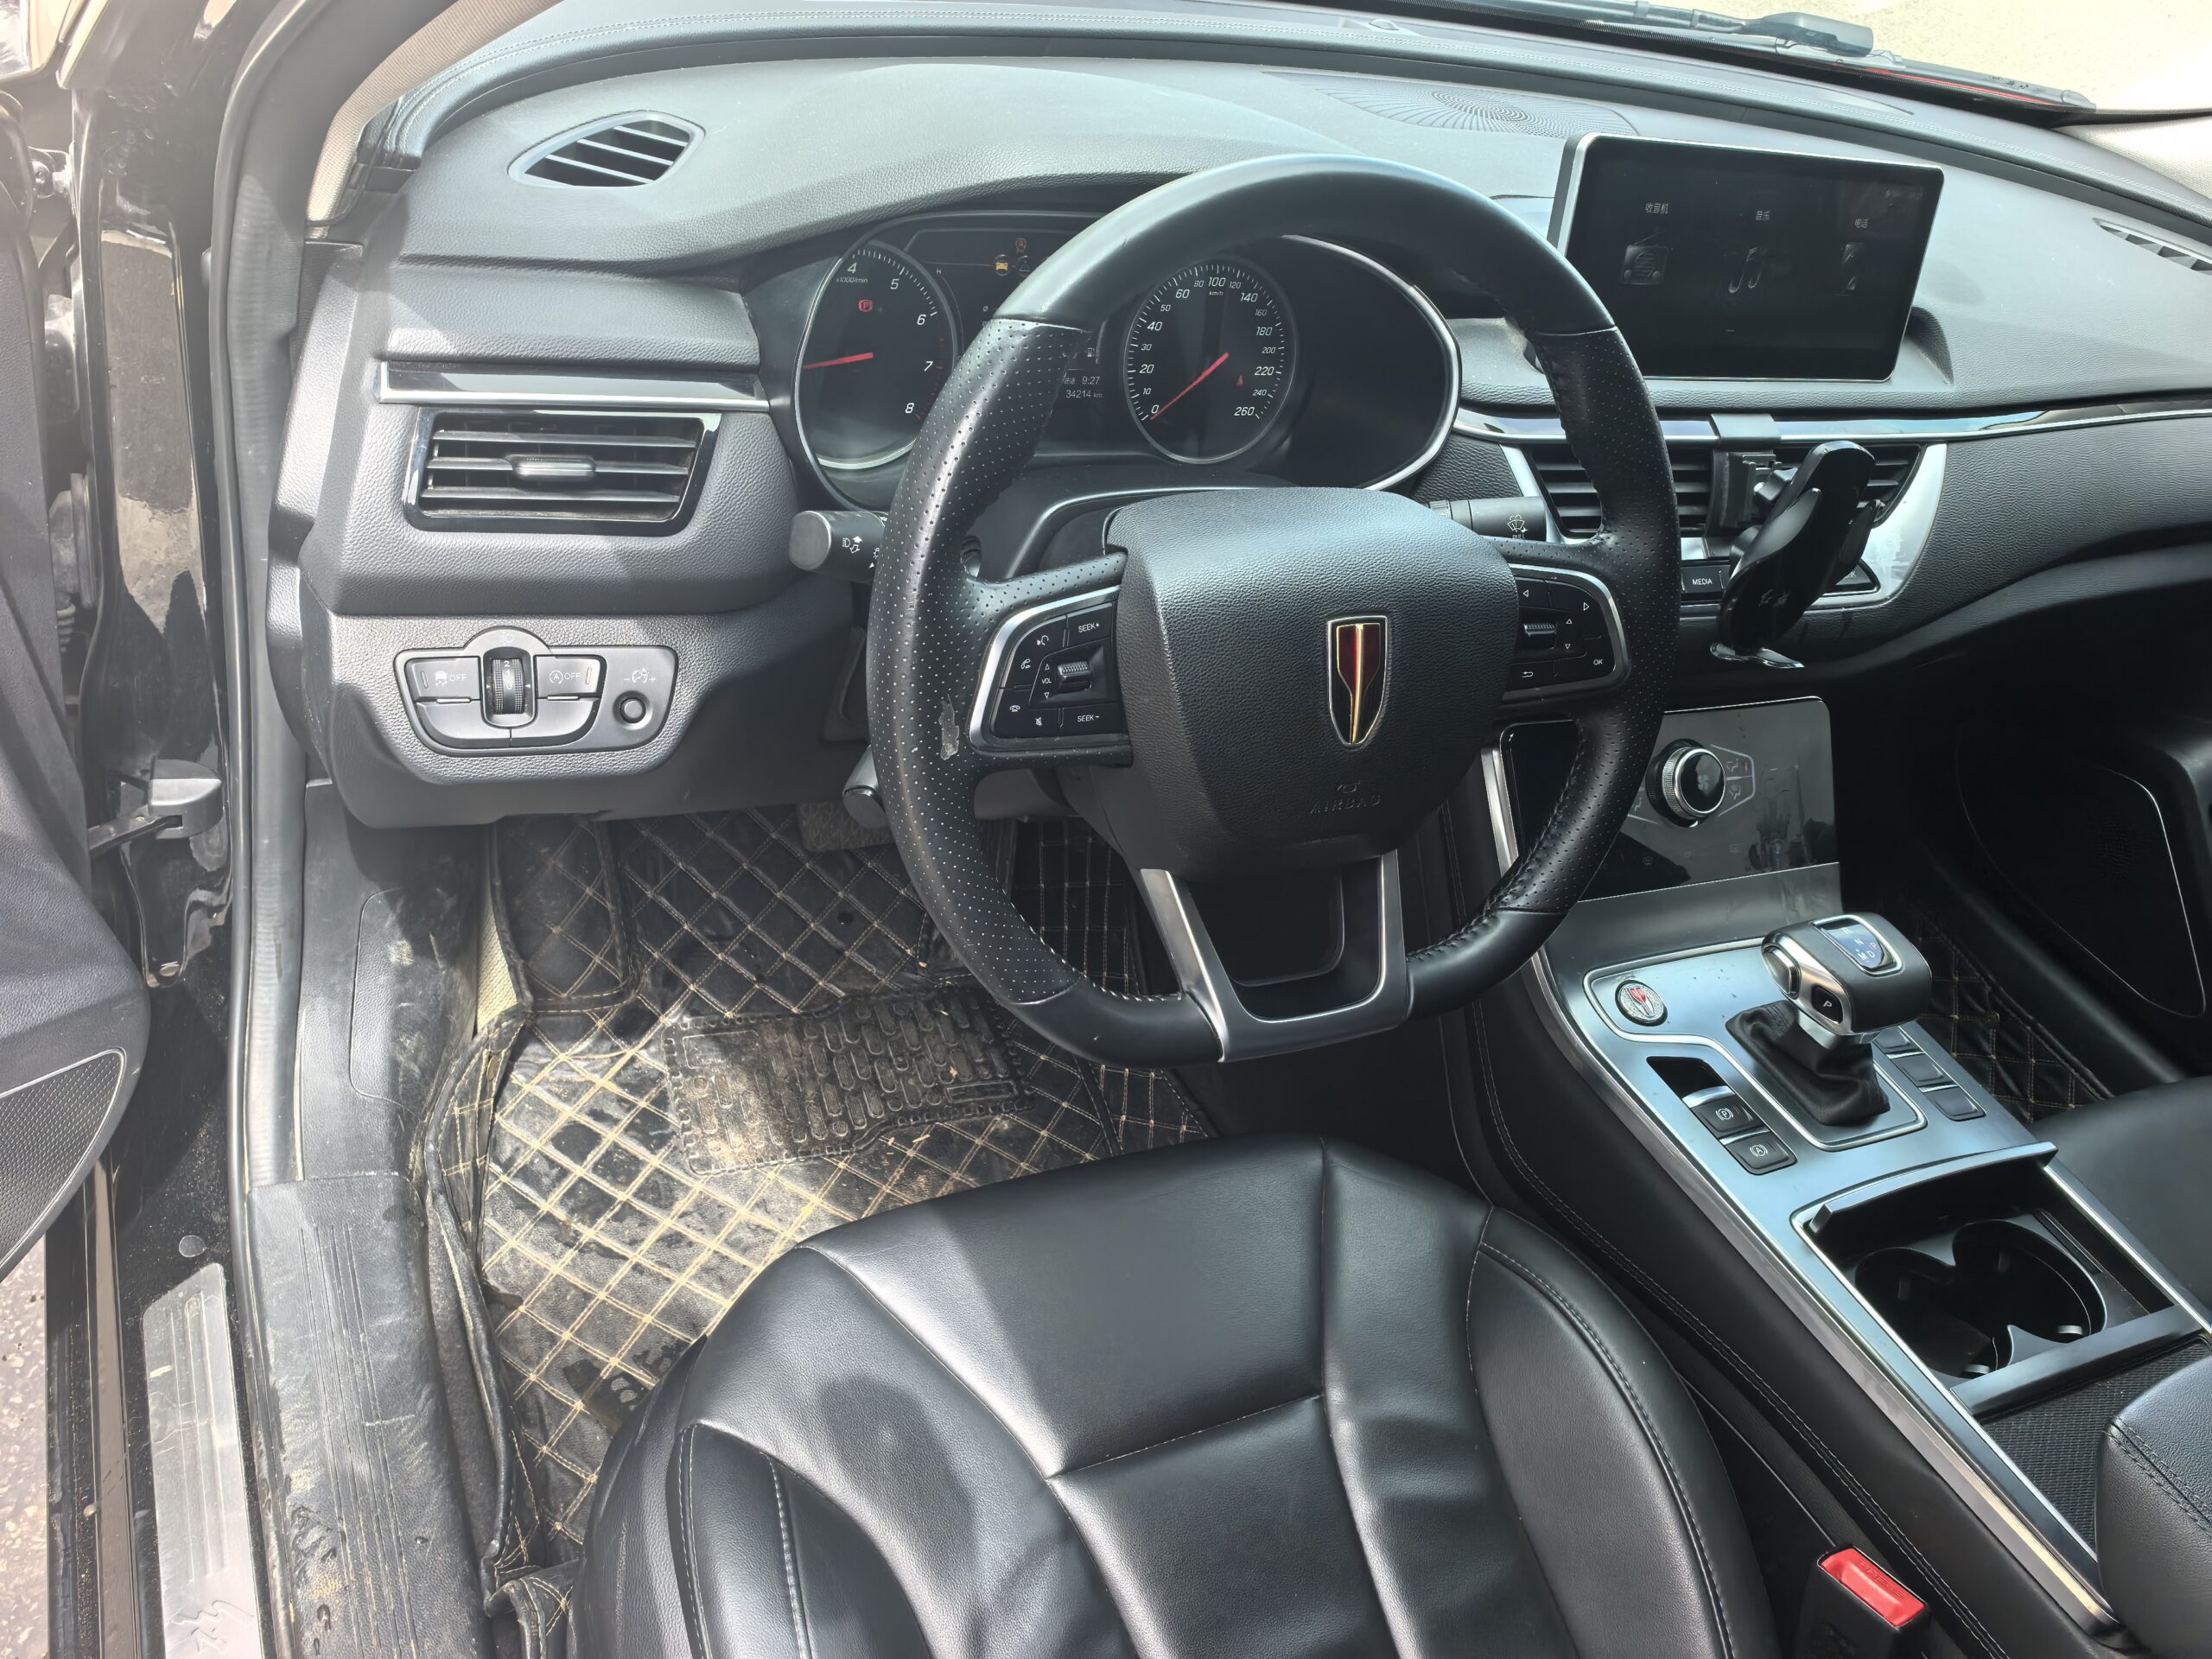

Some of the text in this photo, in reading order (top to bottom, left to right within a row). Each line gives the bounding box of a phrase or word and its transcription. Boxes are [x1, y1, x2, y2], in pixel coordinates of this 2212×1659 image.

[1645, 202, 1669, 214] 收音机
[1756, 210, 1770, 221] 音乐
[1854, 219, 1868, 228] 电话
[847, 262, 857, 274] 4
[890, 278, 900, 289] 5
[1209, 276, 1226, 287] 100
[1229, 281, 1242, 289] 120
[1175, 289, 1191, 299] 60
[1240, 293, 1258, 302] 140
[917, 314, 926, 325] 6
[1147, 321, 1163, 331] 40
[1256, 327, 1273, 336] 180
[924, 360, 933, 372] 7
[1139, 364, 1154, 373] 20
[1254, 366, 1274, 376] 220
[1082, 376, 1100, 385] 9:27
[1065, 389, 1091, 398] 34214
[905, 403, 914, 414] 8
[1151, 404, 1160, 414] 0
[1234, 406, 1255, 416] 260
[1857, 951, 1868, 961] M
